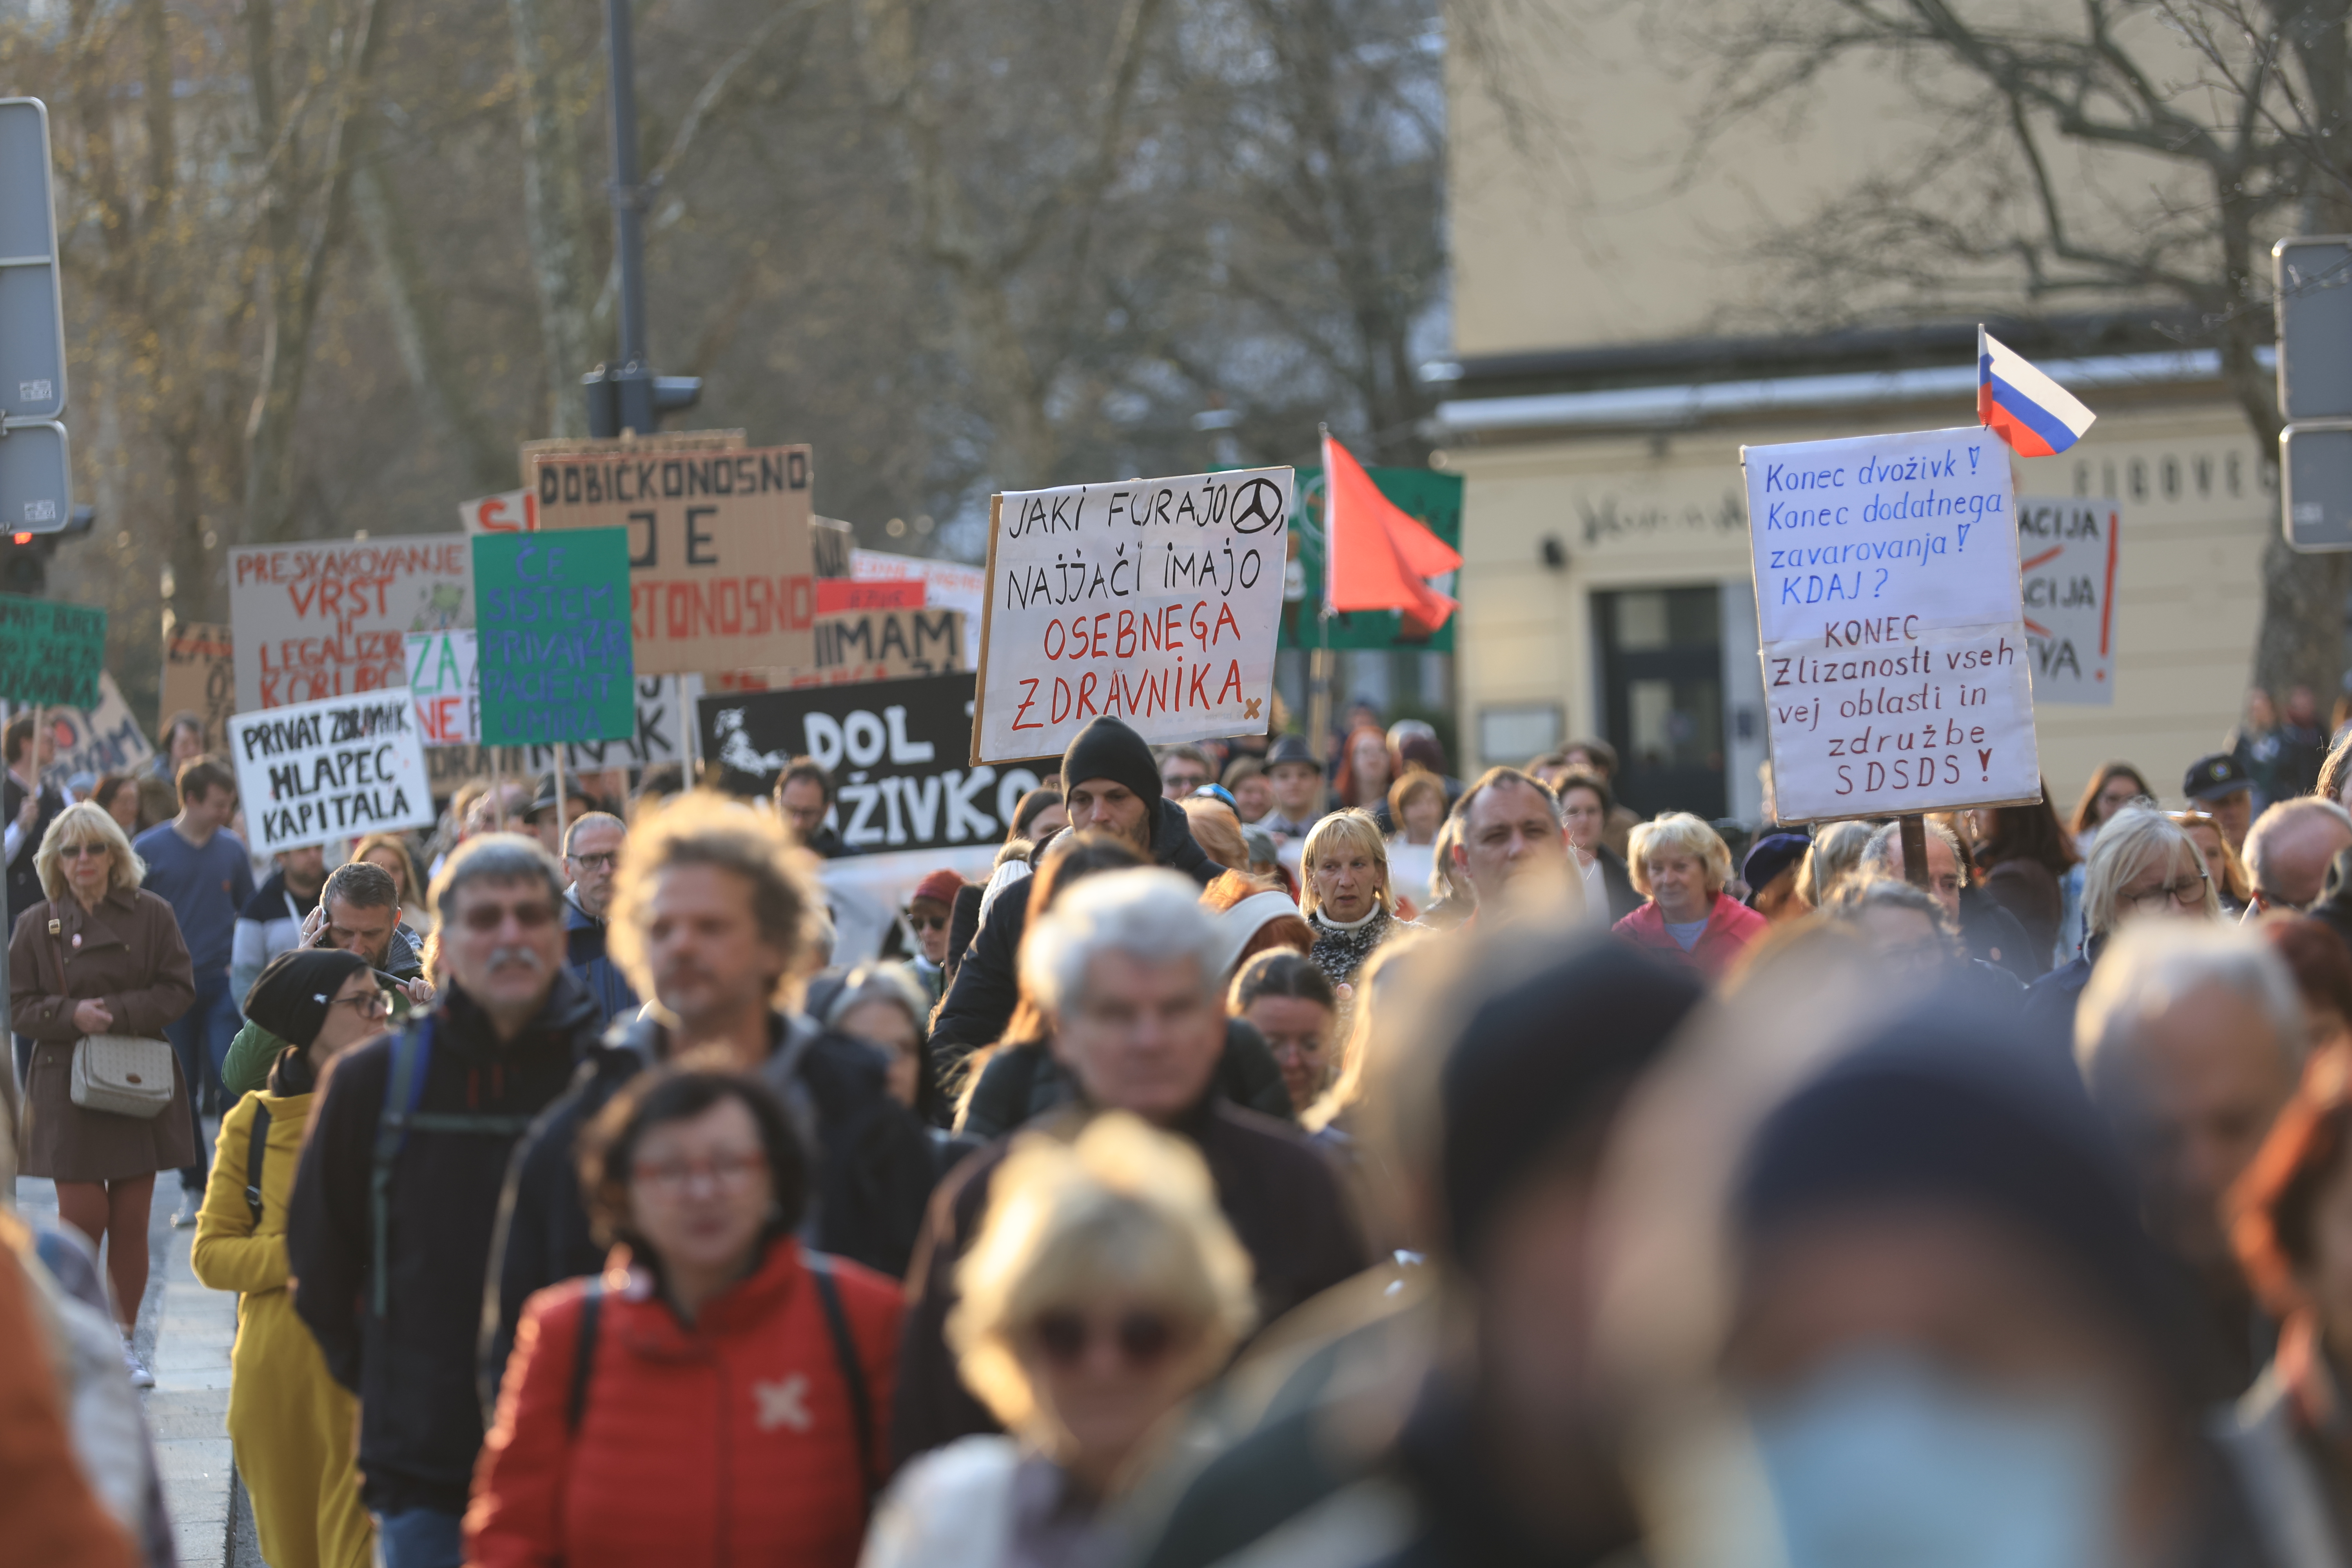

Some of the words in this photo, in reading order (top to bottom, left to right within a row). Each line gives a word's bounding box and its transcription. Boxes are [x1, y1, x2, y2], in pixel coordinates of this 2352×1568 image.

[1766, 463, 1845, 493] Konec
[1009, 485, 1086, 539] JAKI
[1767, 502, 1849, 531] Konec
[1863, 488, 2004, 524] dodatnega
[514, 534, 567, 583] ČE
[1163, 537, 1261, 597] IMAJO
[287, 574, 395, 619] VRST
[486, 581, 615, 624] SISTEM
[1044, 600, 1241, 661] OSEBNEGA
[1825, 614, 1920, 648] KONEC
[406, 632, 463, 696] ZA
[484, 668, 615, 705] PACIENT
[1771, 645, 1931, 687] Zlizanosti
[1947, 637, 2014, 671] vseh
[1011, 655, 1243, 731] ZDRAVNIKA
[1778, 697, 1821, 732] vej
[1840, 683, 1942, 718] oblasti
[1960, 684, 1987, 706] in
[242, 714, 322, 761] PRIVAT
[501, 706, 604, 739] UMIRA
[802, 704, 935, 771] DOL
[1828, 718, 1986, 757] združbe
[269, 744, 394, 800] HLAPEC
[262, 786, 410, 845] KAPITALA
[821, 765, 1043, 847] ŽIVKO
